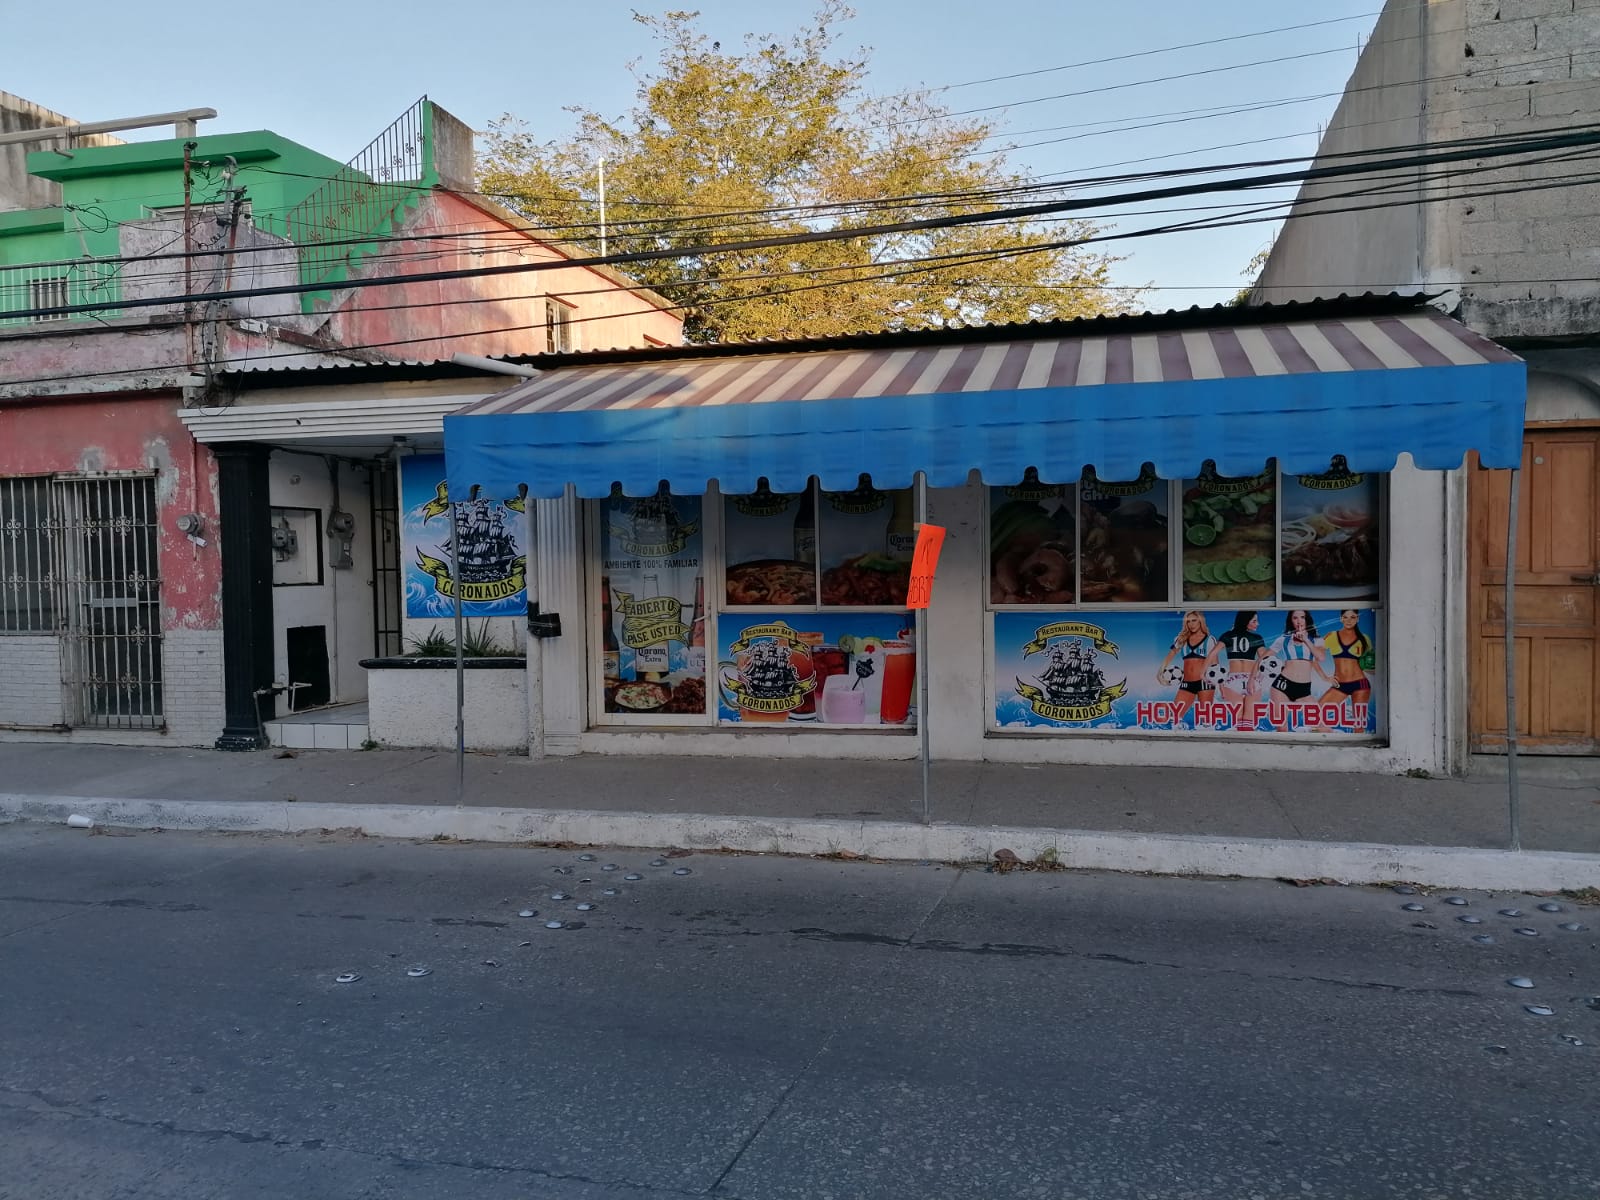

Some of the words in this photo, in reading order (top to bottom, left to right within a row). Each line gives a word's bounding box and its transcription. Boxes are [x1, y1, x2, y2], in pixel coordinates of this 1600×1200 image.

[1303, 478, 1356, 489] CORONADOS
[626, 542, 680, 556] CORONADOS
[604, 559, 641, 569] AMBIENTE
[664, 558, 698, 568] FAMILIAR
[629, 600, 674, 616] ABIERTO
[627, 630, 649, 645] PASE
[651, 625, 681, 640] USTED
[1231, 636, 1250, 653] 10
[742, 696, 797, 710] CORONADOS
[1038, 704, 1104, 719] CORONADOS
[1137, 702, 1184, 725] HOY
[1194, 703, 1242, 726] HAY
[1253, 702, 1368, 728] FUTBOL!!
